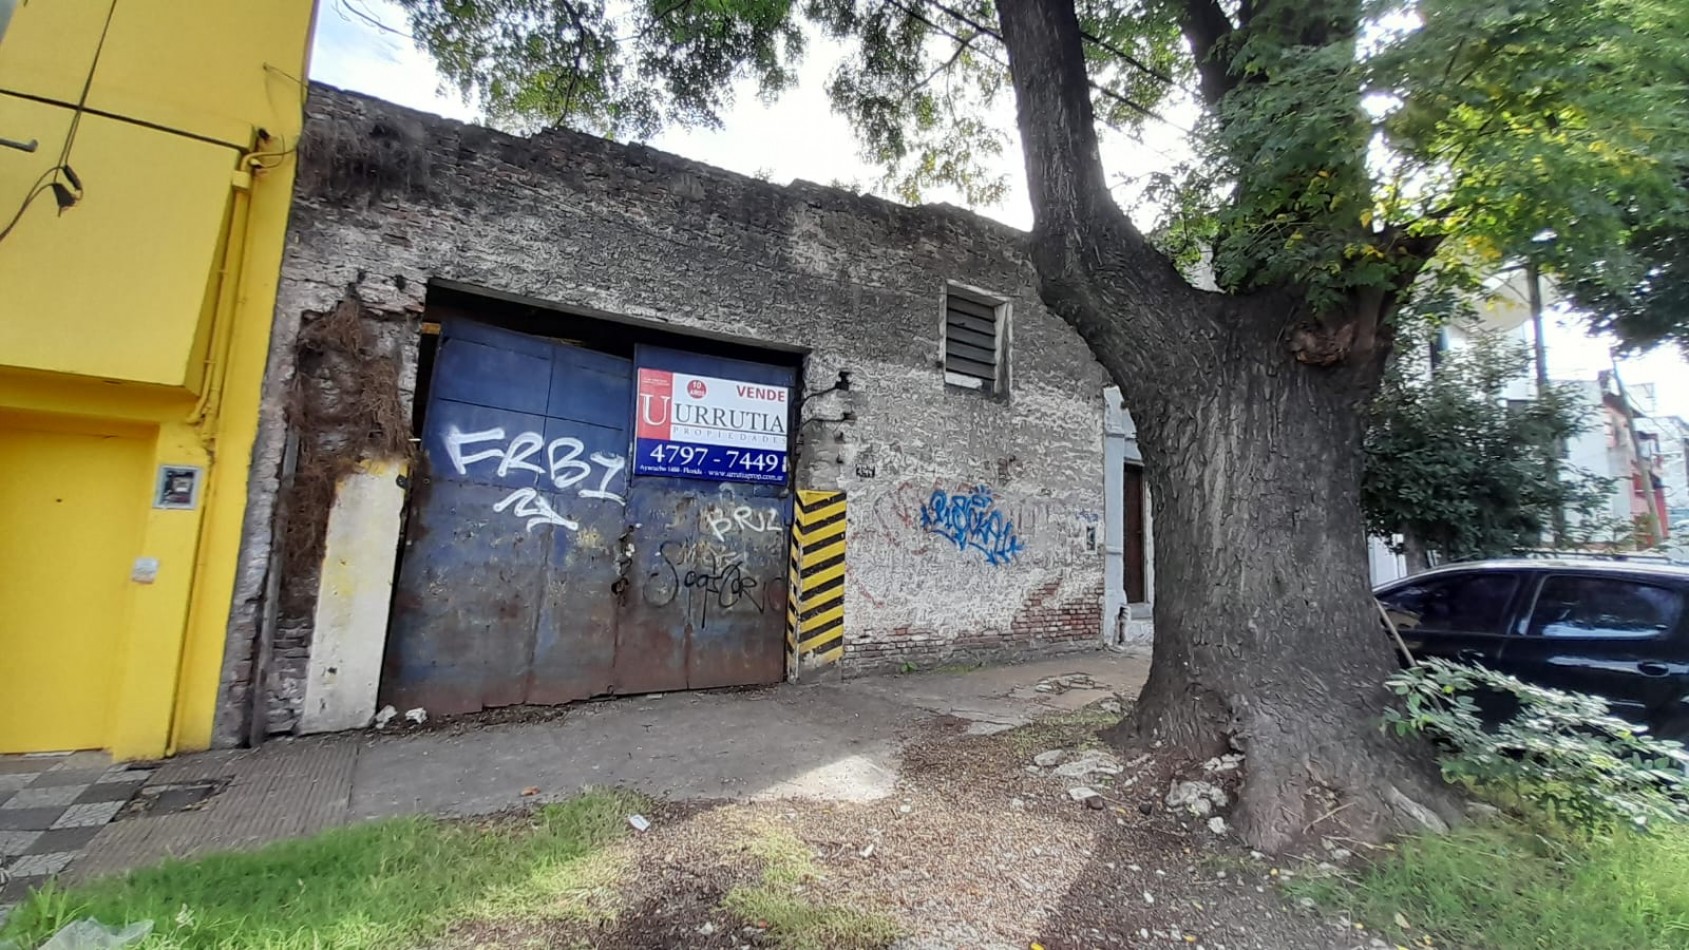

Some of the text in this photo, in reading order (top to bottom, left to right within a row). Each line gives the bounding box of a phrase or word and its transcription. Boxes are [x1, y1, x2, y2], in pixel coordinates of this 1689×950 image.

[692, 381, 702, 389] 10
[736, 385, 786, 402] VENDE
[639, 392, 671, 426] U
[674, 403, 785, 433] URRUTIA
[673, 428, 786, 444] PROPIEDADES
[650, 443, 708, 466] 4797
[726, 451, 778, 472] 7449
